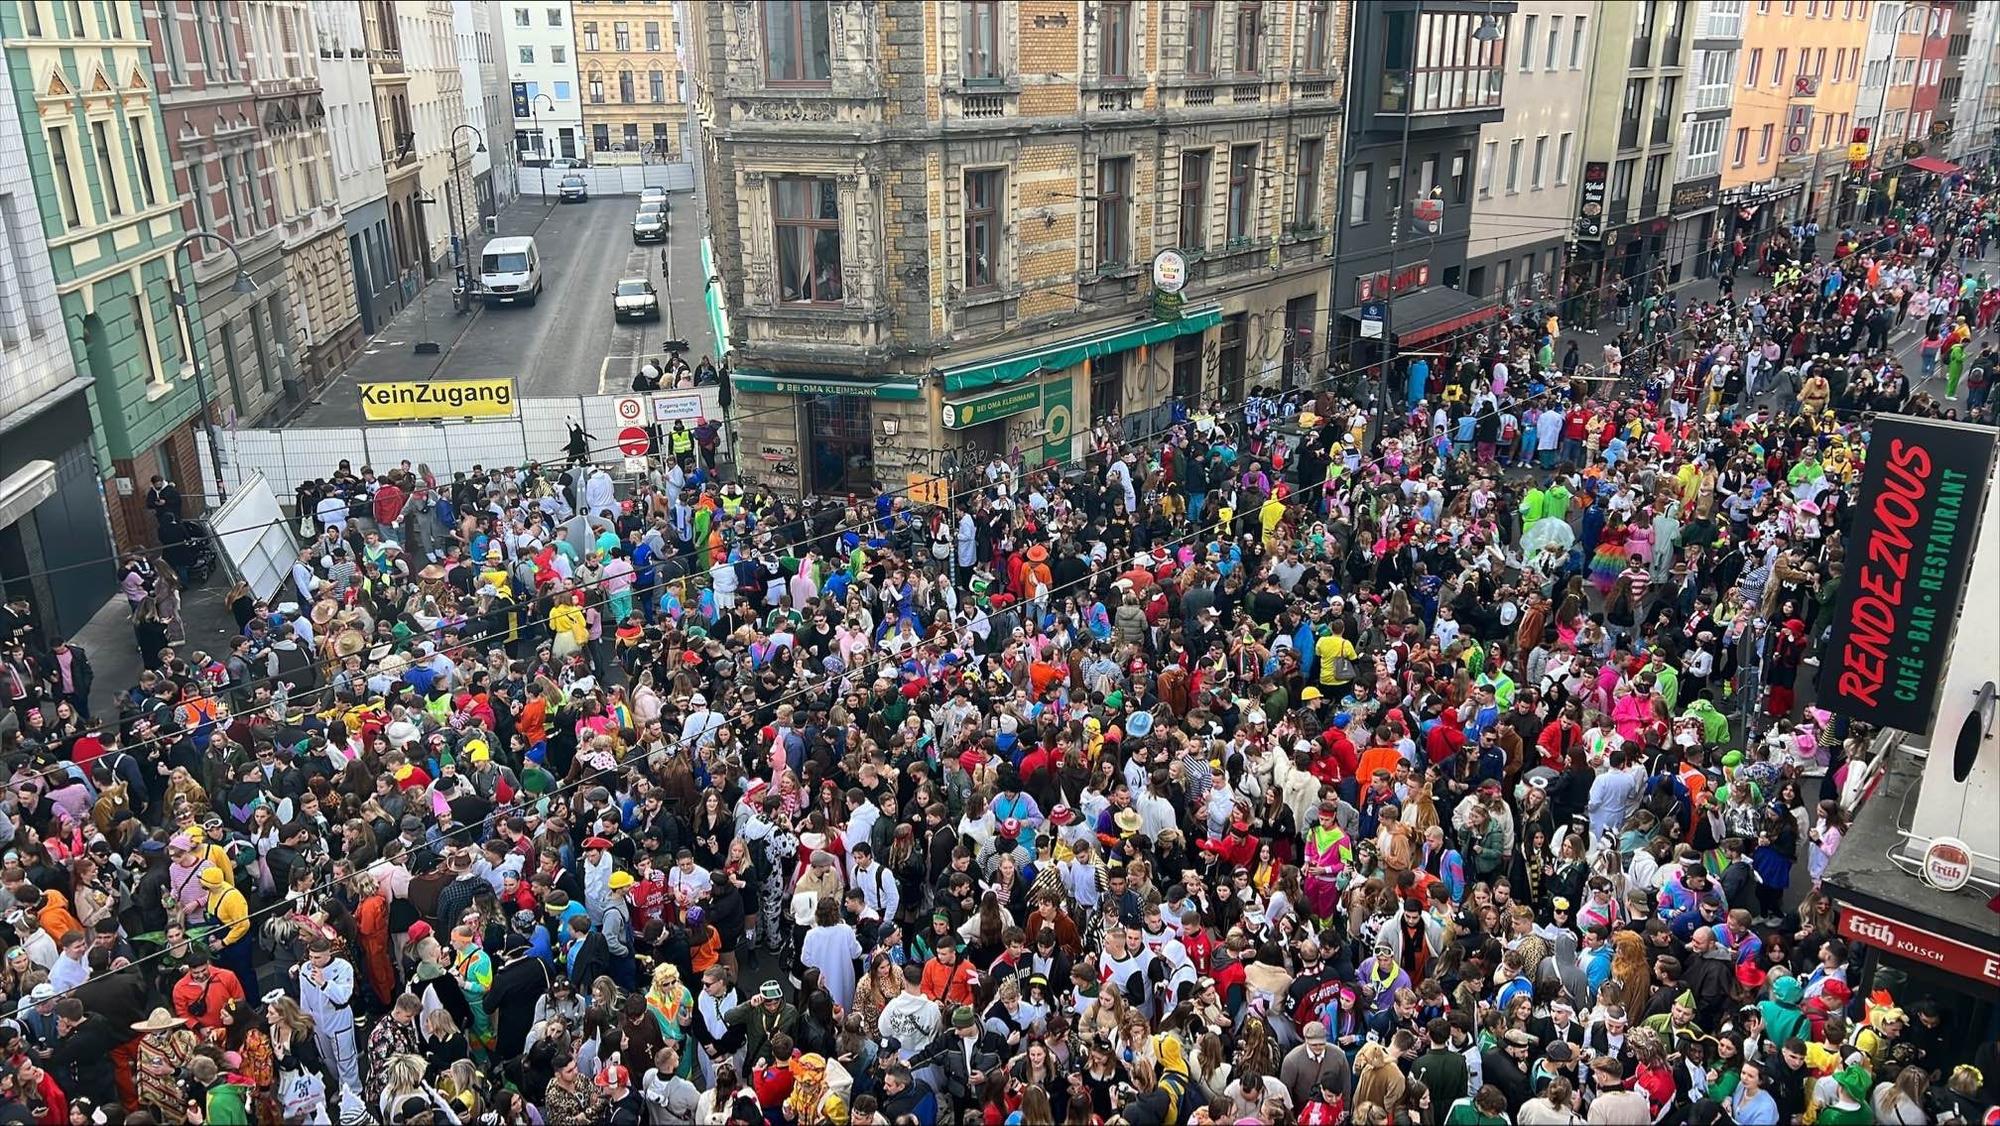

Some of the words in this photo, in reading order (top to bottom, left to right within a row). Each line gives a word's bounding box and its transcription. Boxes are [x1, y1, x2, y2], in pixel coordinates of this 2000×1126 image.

[787, 384, 800, 392] BEI
[803, 385, 823, 393] OMA
[825, 386, 877, 396] KLEINMANN
[623, 404, 636, 415] 30
[977, 404, 986, 413] BEI
[988, 400, 1001, 410] OMA
[1002, 392, 1035, 406] KLEINMANN
[1919, 469, 1968, 591] RESTAURANT
[1839, 438, 1933, 708] RENDEZVOUS
[1907, 605, 1937, 643] BAR
[1894, 656, 1925, 702] CAFÉ
[1897, 940, 1945, 962] KÖLSCH
[1983, 958, 2000, 981] E
